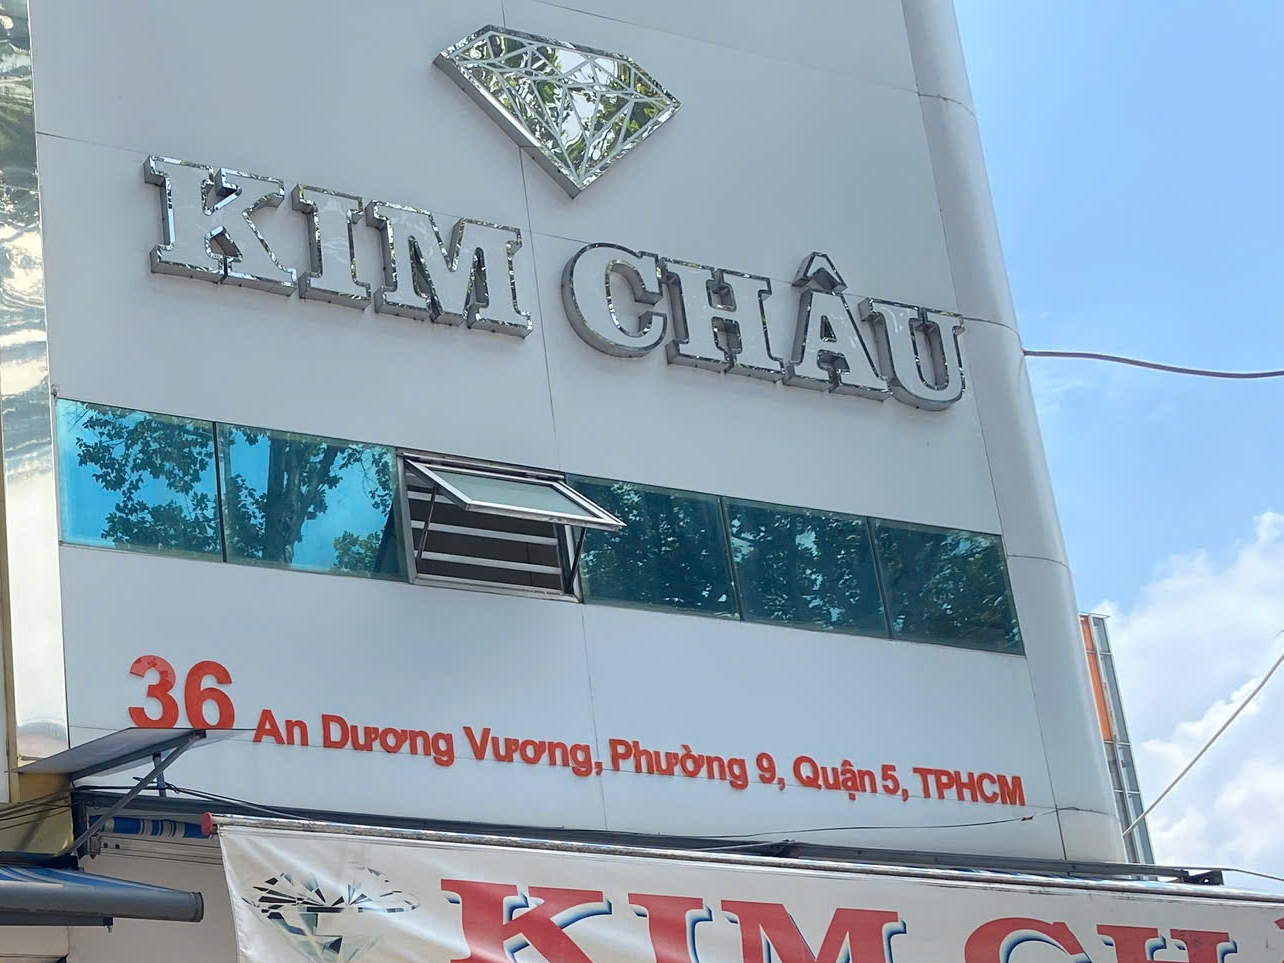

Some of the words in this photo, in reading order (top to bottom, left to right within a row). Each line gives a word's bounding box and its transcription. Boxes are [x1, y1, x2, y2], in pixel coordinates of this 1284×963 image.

[143, 155, 534, 338] KIM
[562, 242, 967, 411] CHÂU
[127, 654, 236, 730] 36
[253, 708, 309, 746] An
[321, 713, 454, 767] Dương
[463, 726, 603, 777] Vương,
[609, 738, 749, 791] Phường
[755, 752, 786, 792] 9,
[792, 755, 878, 802] Quận
[881, 764, 909, 803] 5,
[912, 767, 1026, 807] TPHCM
